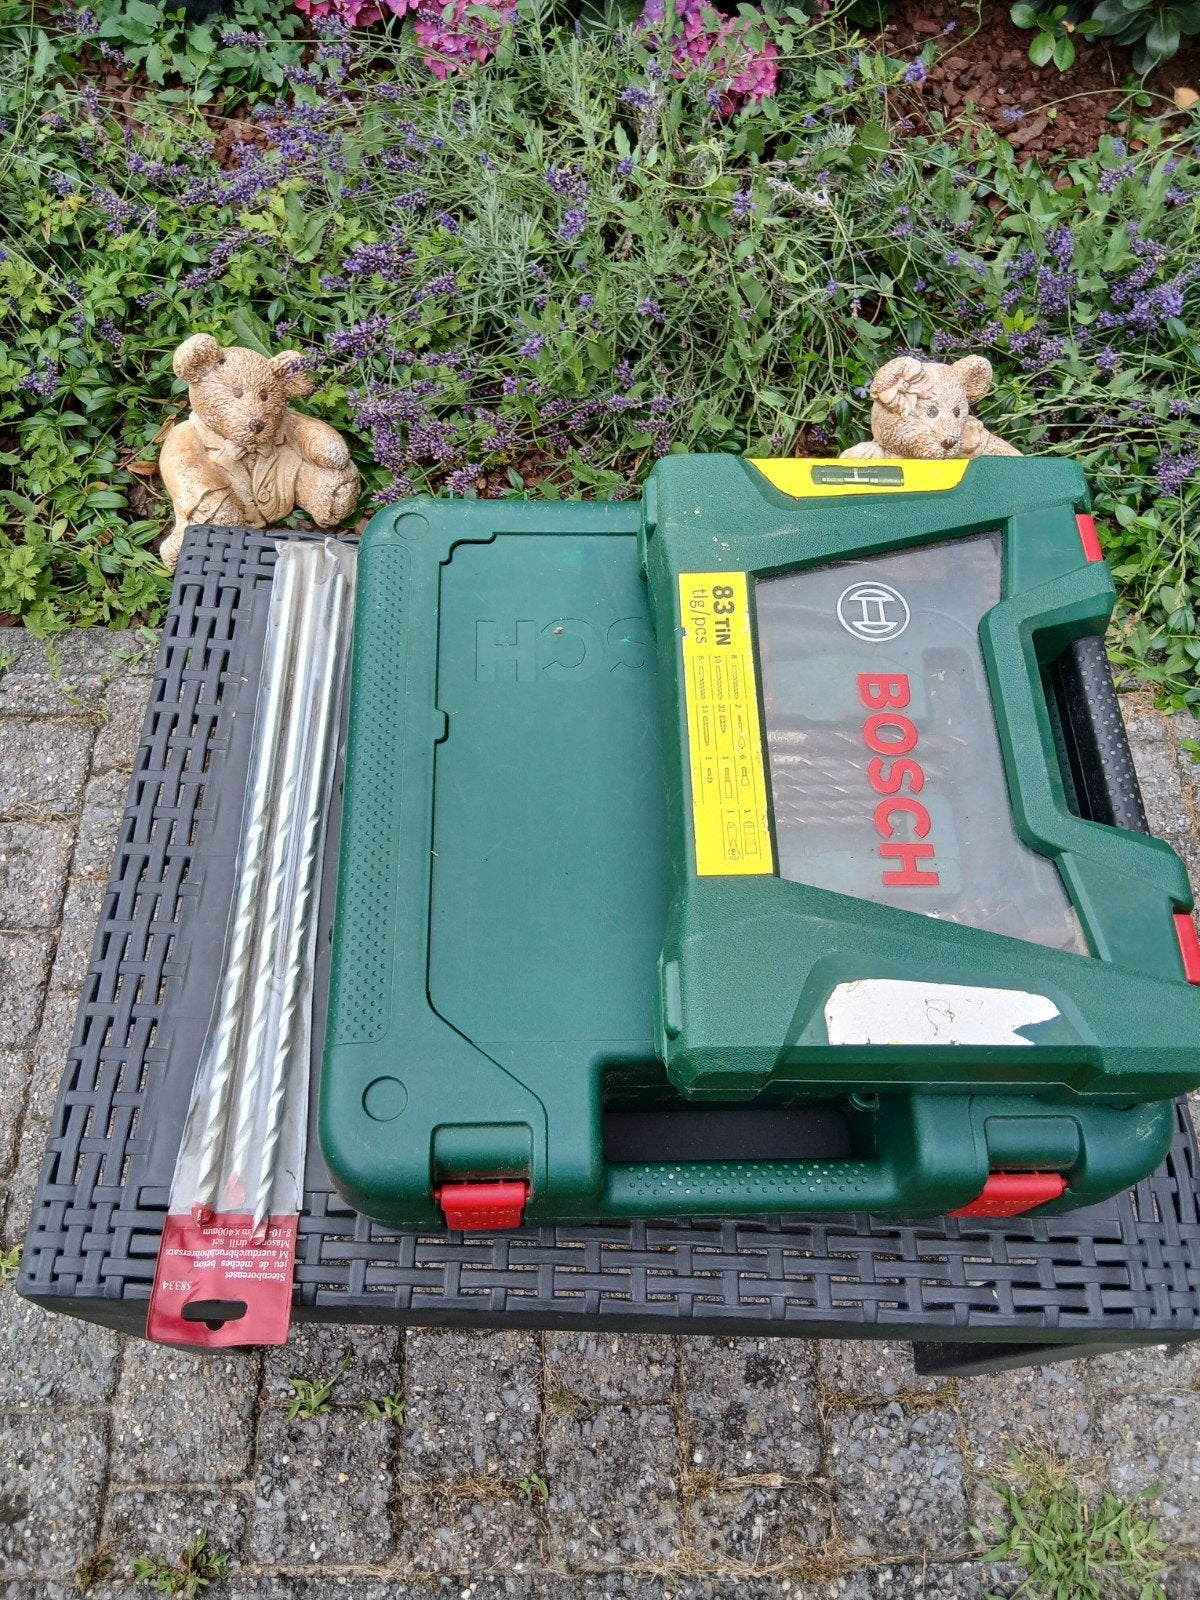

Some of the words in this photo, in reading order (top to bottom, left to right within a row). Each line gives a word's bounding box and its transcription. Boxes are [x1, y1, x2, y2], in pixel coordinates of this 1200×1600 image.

[712, 585, 735, 615] 83
[689, 588, 711, 645] tlg/pcs
[714, 617, 732, 646] TiN
[856, 672, 941, 887] BOSCH
[224, 1271, 287, 1281] Steenborenset
[258, 1260, 270, 1269] de
